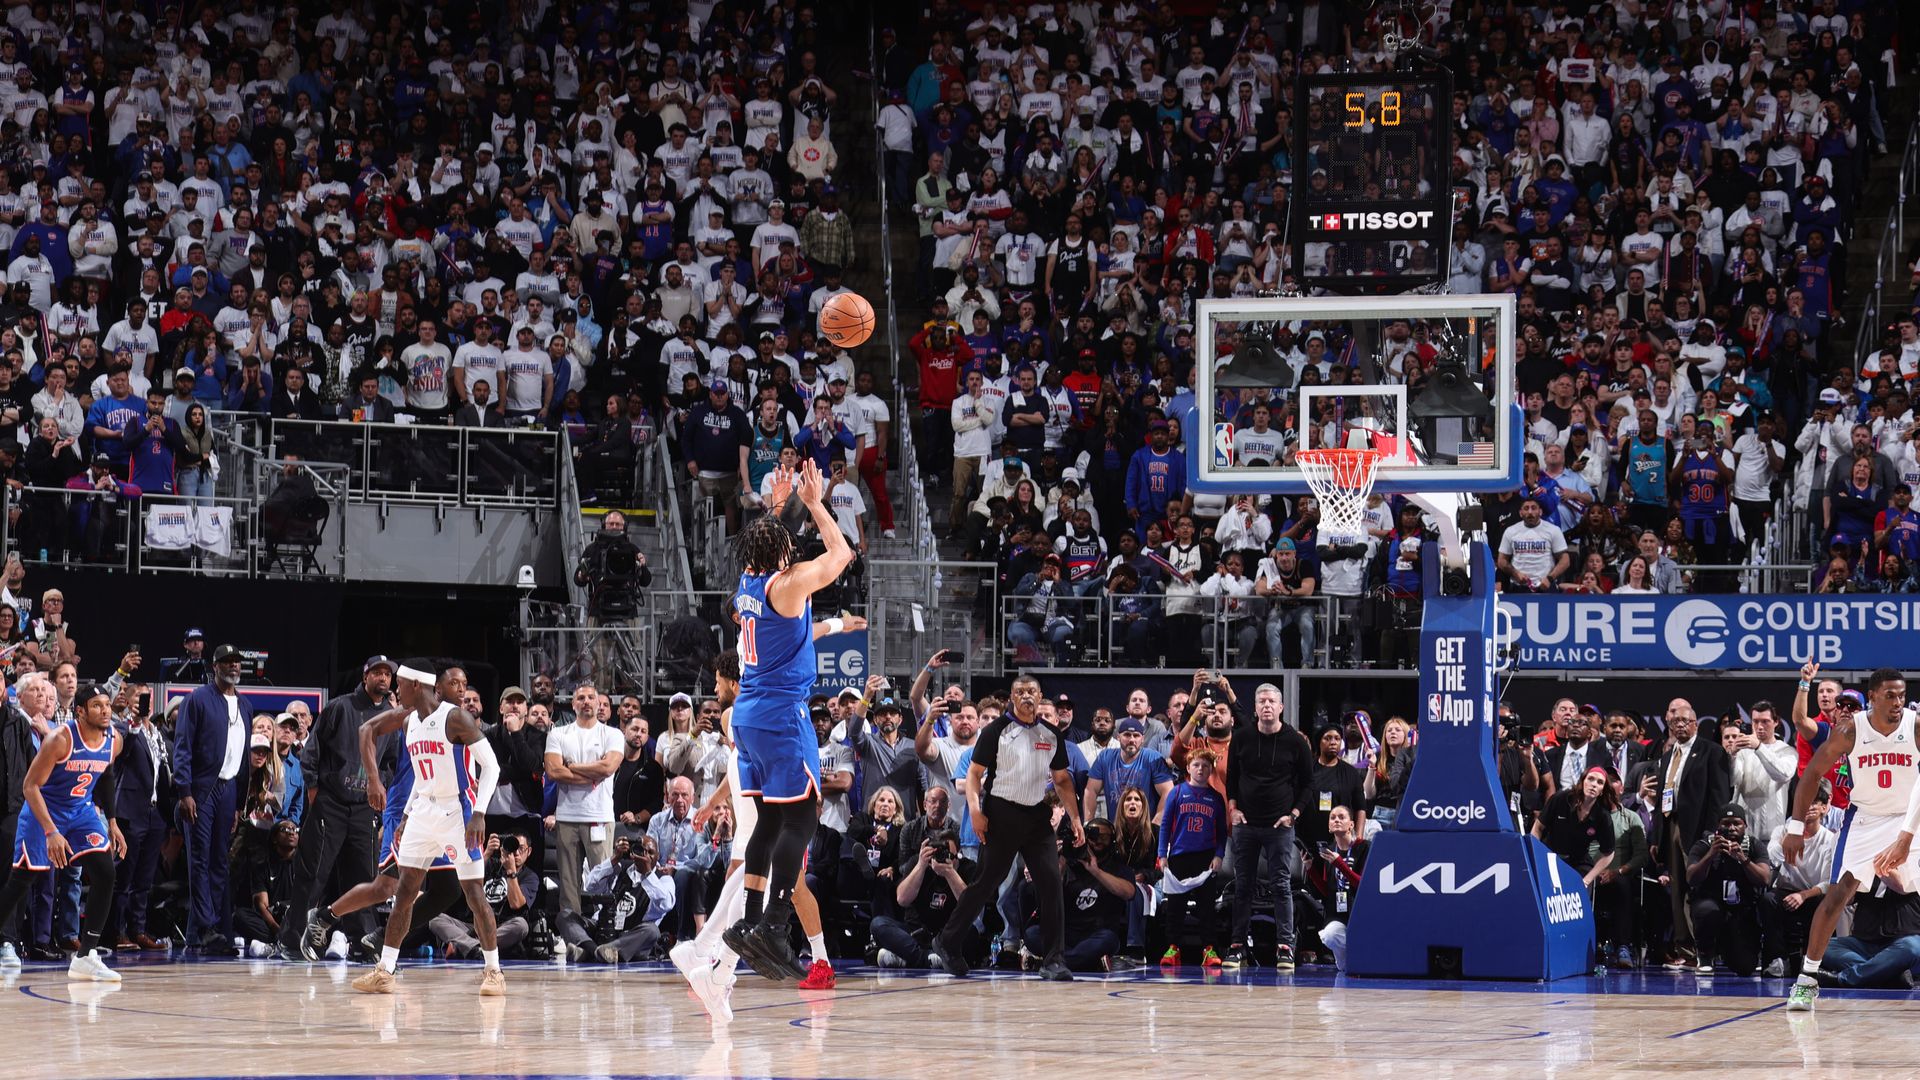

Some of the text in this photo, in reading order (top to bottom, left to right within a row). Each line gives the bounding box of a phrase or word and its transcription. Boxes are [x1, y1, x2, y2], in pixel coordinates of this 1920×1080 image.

[1345, 91, 1401, 127] 5.8
[1343, 211, 1433, 230] TISSOT
[1150, 475, 1165, 492] 11
[1649, 472, 1658, 482] 2
[1688, 483, 1714, 502] 30
[1070, 544, 1097, 556] DET
[737, 594, 762, 617] BRUNSON
[1738, 601, 1920, 631] COURTSI
[740, 616, 758, 667] 11
[1435, 637, 1466, 663] GET
[1738, 634, 1842, 664] CLUB
[1497, 648, 1612, 662] URANCE
[1435, 665, 1466, 691] THE
[1442, 694, 1473, 726] App
[408, 740, 445, 756] PISTONS
[418, 758, 434, 780] 17
[1858, 752, 1912, 768] PISTONS
[70, 773, 93, 797] 2
[1877, 770, 1892, 789] 0
[1179, 803, 1215, 818] DETROIT
[1412, 800, 1486, 824] Google
[1186, 817, 1204, 832] 12
[1379, 862, 1510, 895] KIA
[1546, 888, 1584, 925] coinbase
